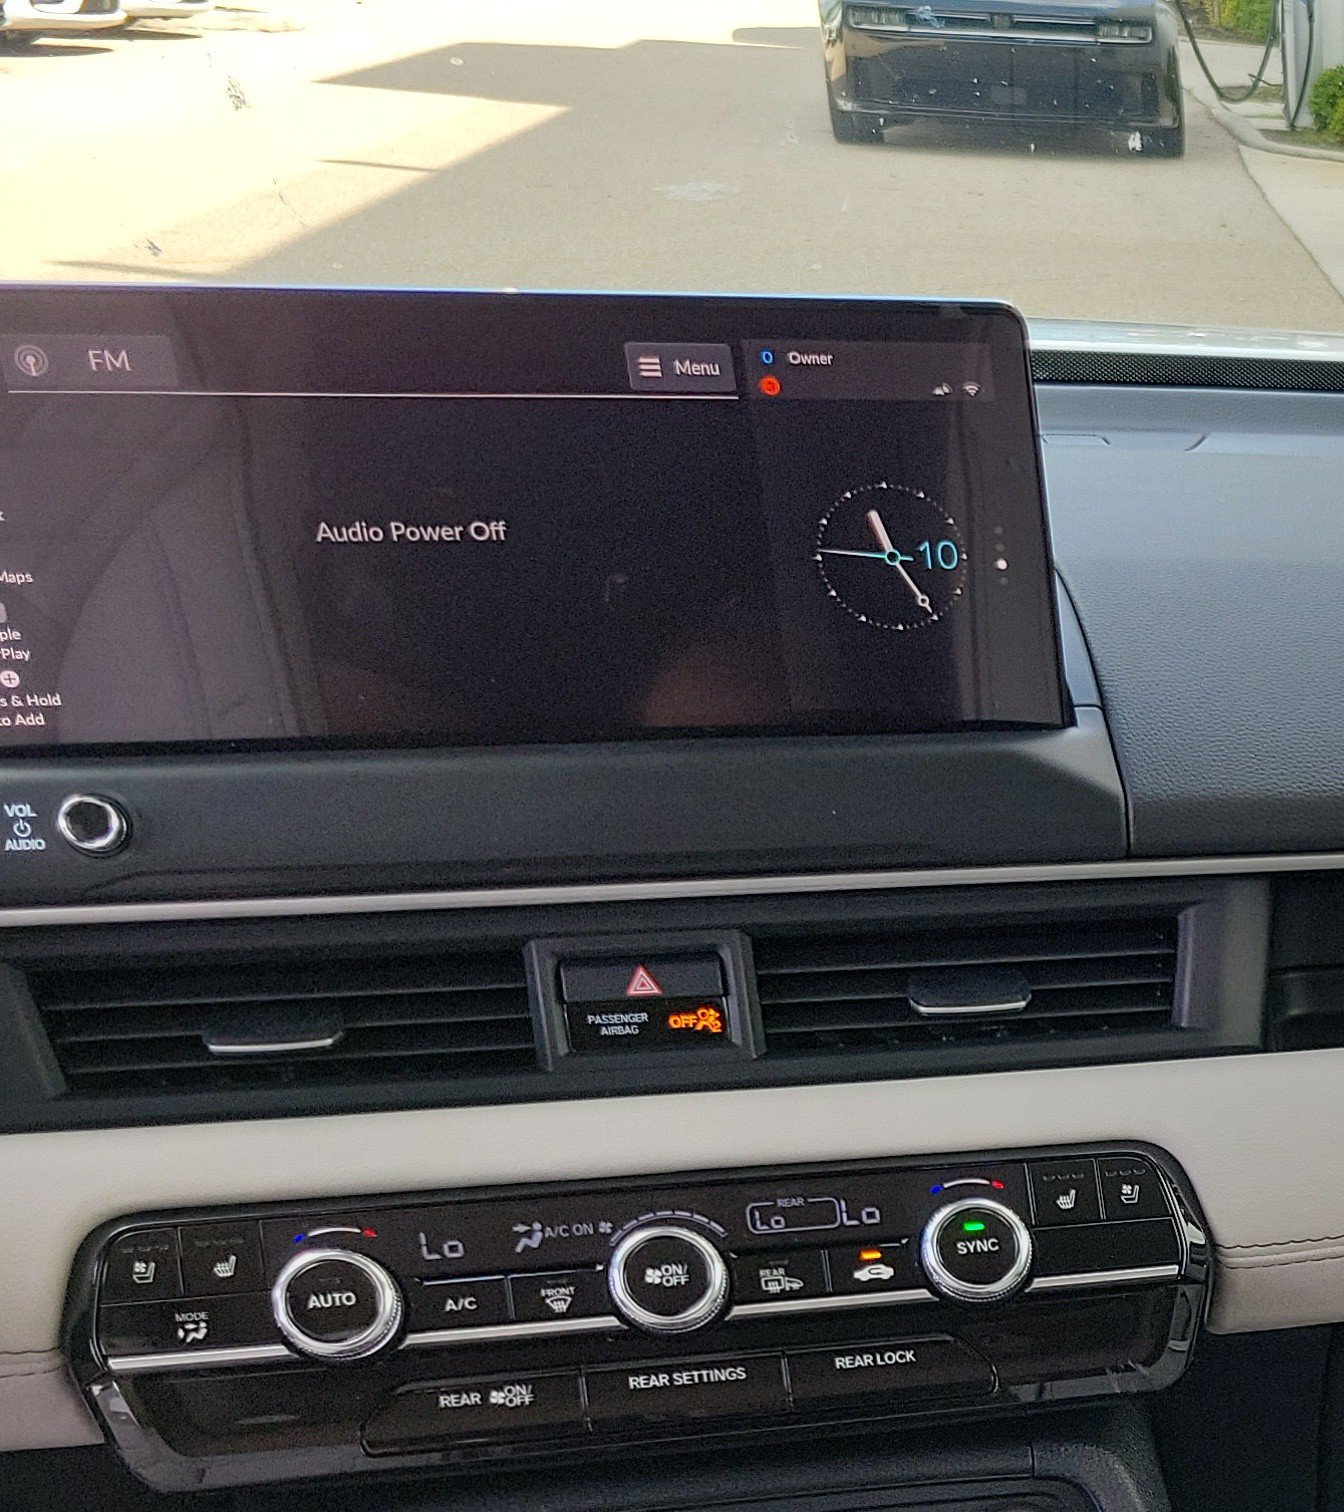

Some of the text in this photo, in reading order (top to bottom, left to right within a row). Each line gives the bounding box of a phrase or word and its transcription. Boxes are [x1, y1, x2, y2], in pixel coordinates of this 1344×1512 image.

[88, 350, 131, 371] FM
[788, 351, 833, 365] Owner
[674, 359, 720, 377] Menu
[316, 521, 508, 543] Audio Power Off
[918, 540, 958, 570] 10
[0, 648, 30, 660] Play
[26, 694, 62, 706] Hold
[15, 713, 46, 725] Add
[4, 805, 37, 818] VOL
[5, 838, 47, 852] AUDIO
[587, 1013, 649, 1025] PASSENGER
[668, 1014, 698, 1028] OFF
[600, 1025, 639, 1036] AIRBAG
[777, 1198, 805, 1208] REAR
[840, 1199, 881, 1226] Lo
[755, 1210, 785, 1230] Lo
[545, 1224, 594, 1239] A/C ON
[419, 1232, 464, 1260] Lo
[957, 1238, 1000, 1255] SYNC
[661, 1264, 688, 1276] ON/
[759, 1268, 785, 1277] REAR
[662, 1274, 690, 1286] OFF
[540, 1286, 576, 1297] FRONT
[307, 1291, 357, 1309] AUTO
[445, 1297, 478, 1312] A/C
[175, 1311, 209, 1322] MODE
[835, 1349, 917, 1370] REAR LOCK
[629, 1366, 747, 1390] REAR SETTINGS
[505, 1384, 533, 1397] ON/
[439, 1392, 482, 1408] REAR
[505, 1395, 534, 1408] OFF
